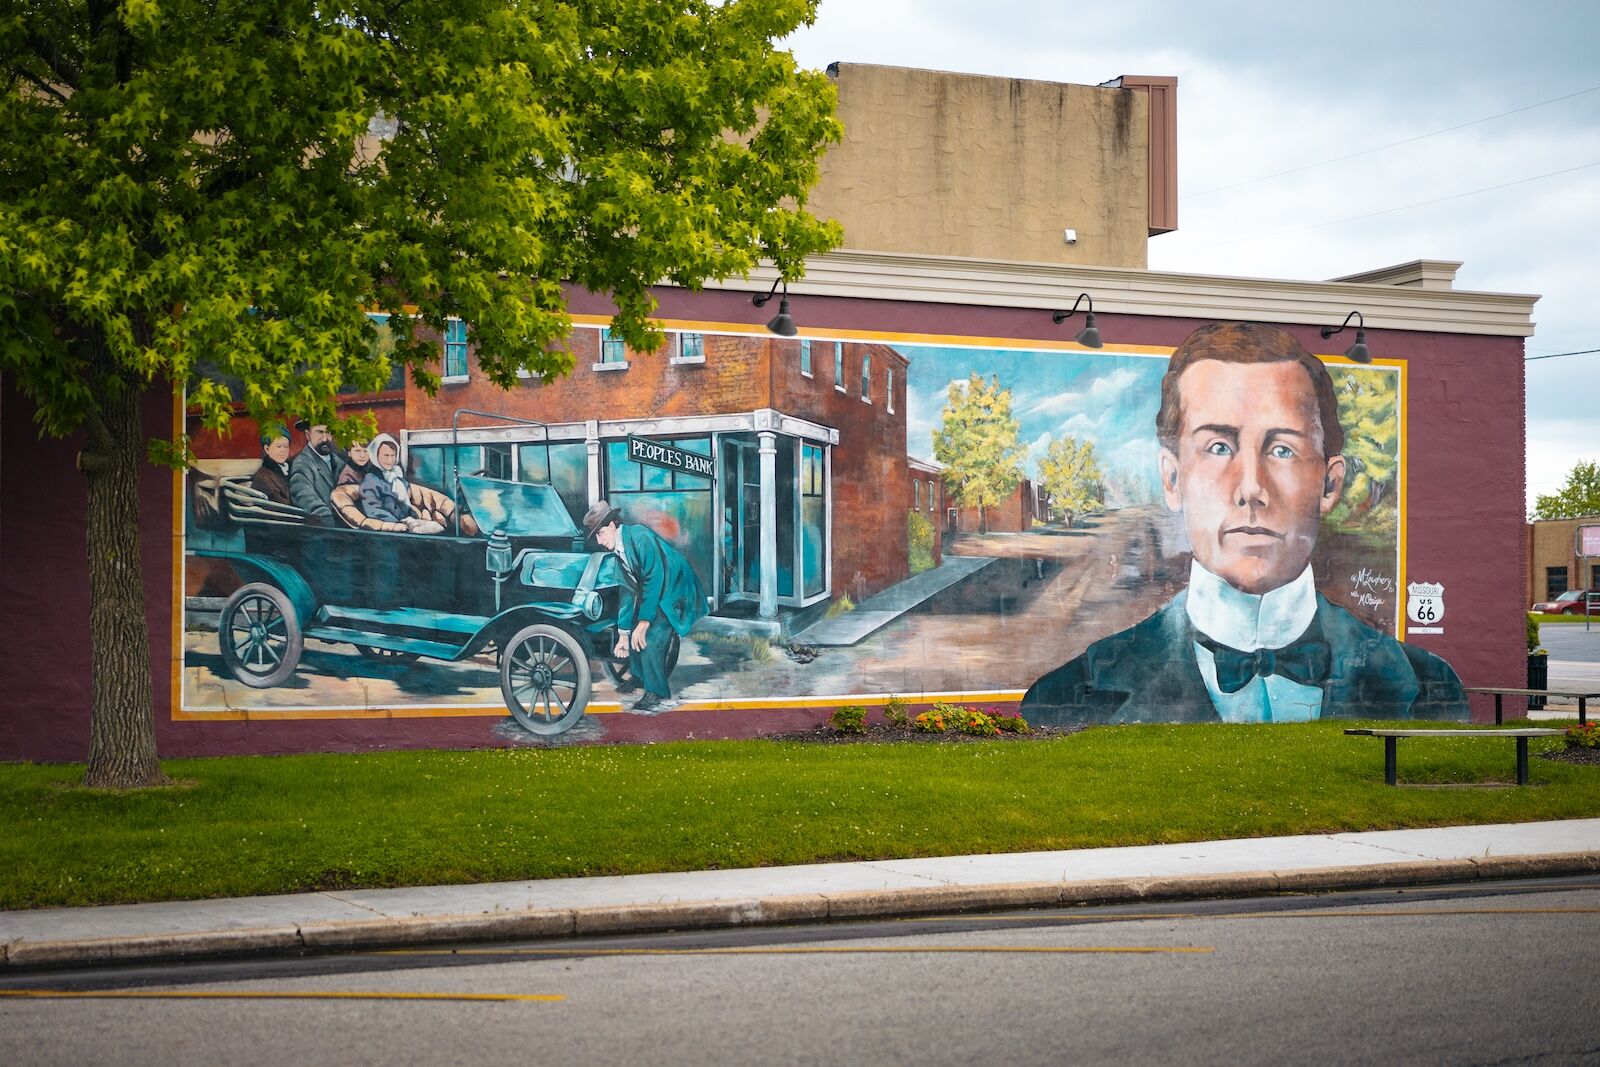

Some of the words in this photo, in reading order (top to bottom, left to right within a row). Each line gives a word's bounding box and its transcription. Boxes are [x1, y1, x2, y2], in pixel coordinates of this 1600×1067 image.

[632, 440, 682, 467] PEOPLES
[685, 455, 714, 475] BANK
[1411, 585, 1440, 595] MISSOURI
[1417, 605, 1435, 620] 66
